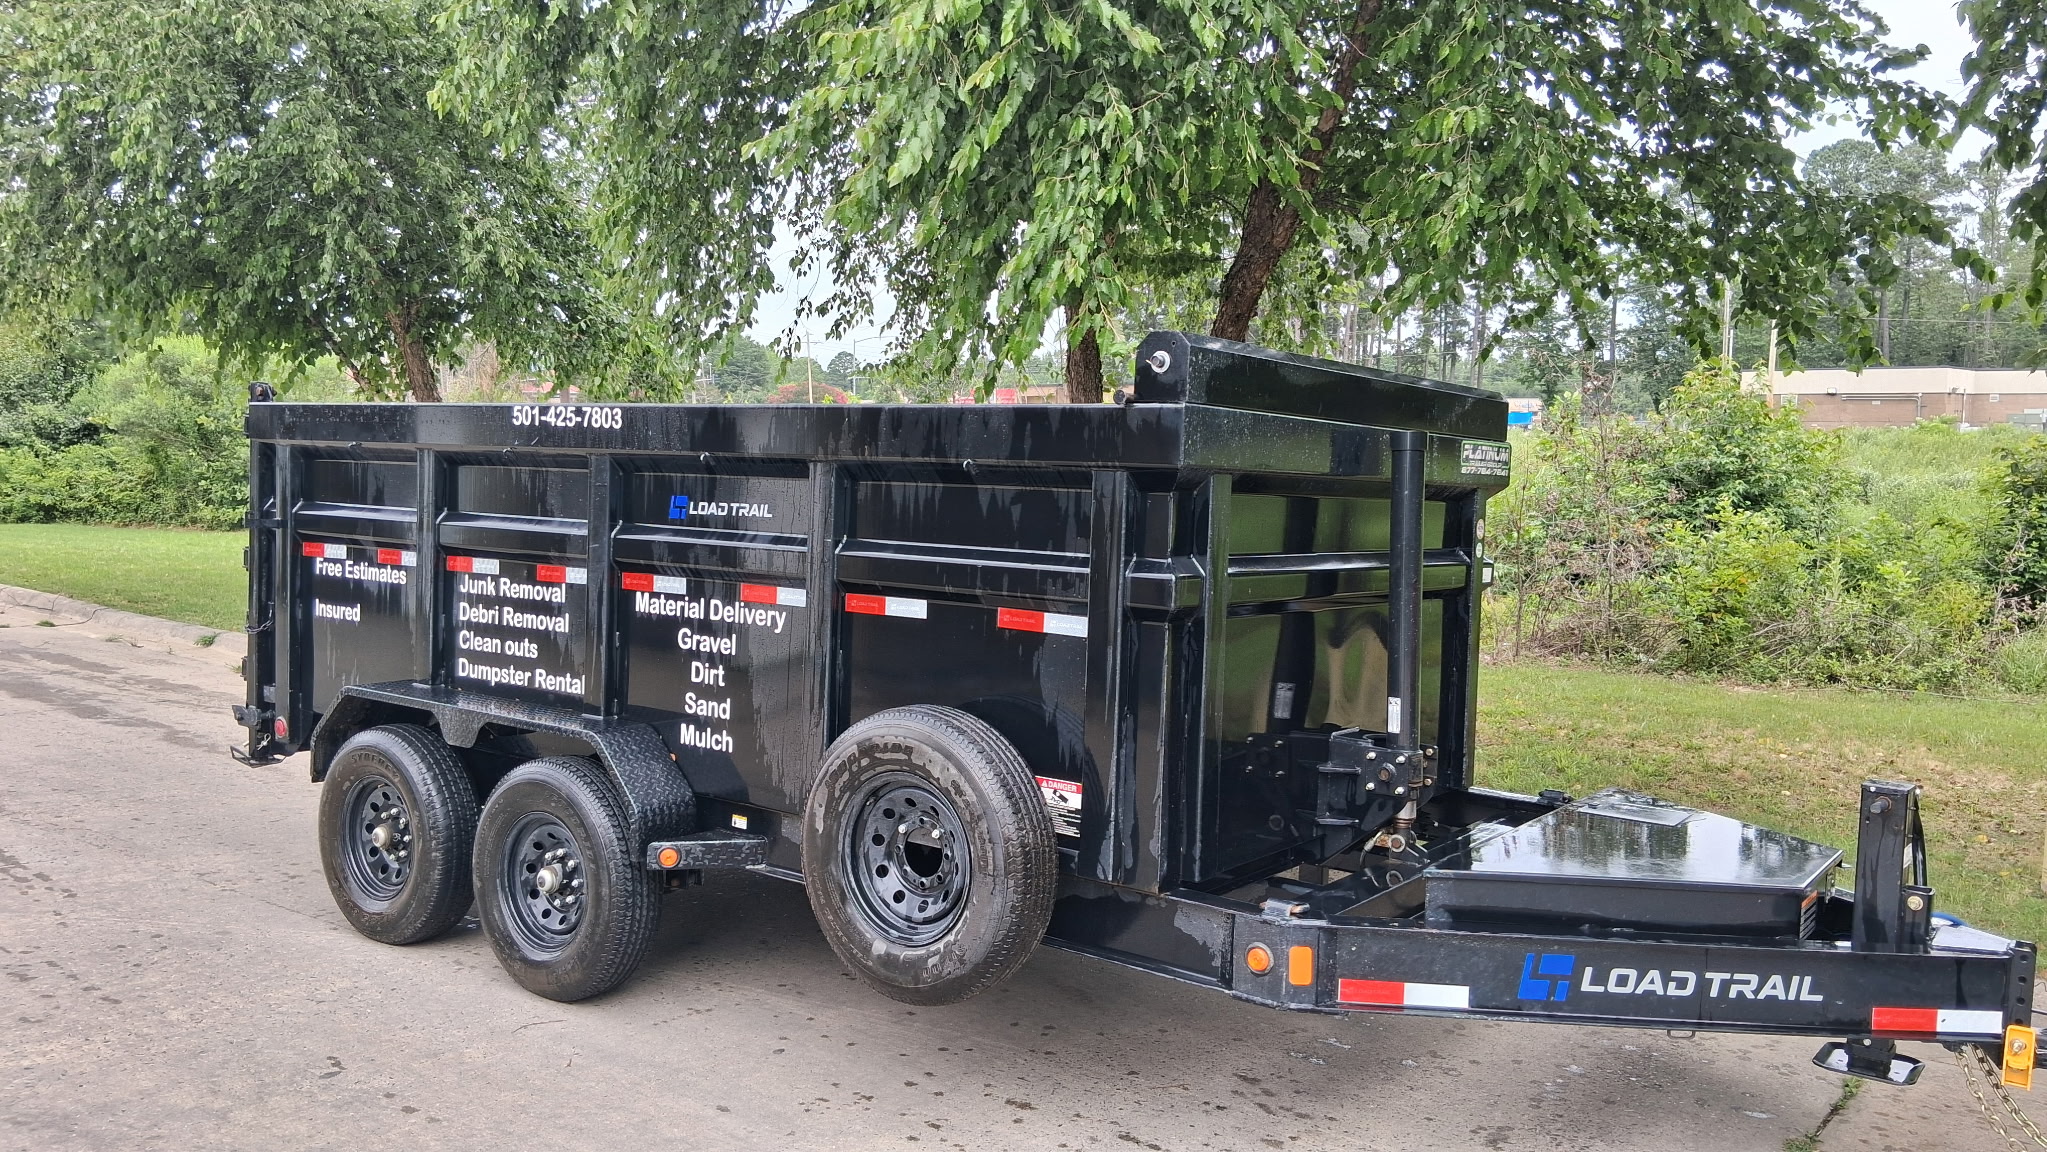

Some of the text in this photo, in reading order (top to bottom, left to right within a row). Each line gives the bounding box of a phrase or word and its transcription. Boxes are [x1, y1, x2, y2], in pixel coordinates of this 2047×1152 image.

[511, 404, 623, 429] 501-425-7803
[1463, 449, 1509, 462] PLATINUM
[688, 501, 773, 518] LOAD TRAIL
[315, 557, 407, 585] Free Estimates
[459, 572, 566, 604] Junk Removal
[315, 598, 361, 623] Insured
[458, 601, 570, 634] Debri Removal
[635, 590, 787, 634] Material Delivery
[458, 629, 539, 659] Clean outs
[677, 627, 737, 656] Gravel
[457, 657, 586, 695] Dumpster Rental
[690, 660, 726, 687] Dirt
[684, 691, 731, 721] Sand
[680, 722, 733, 754] Mulch
[1048, 781, 1077, 792] DANGER
[1580, 966, 1824, 1002] LOAD TRAIL
